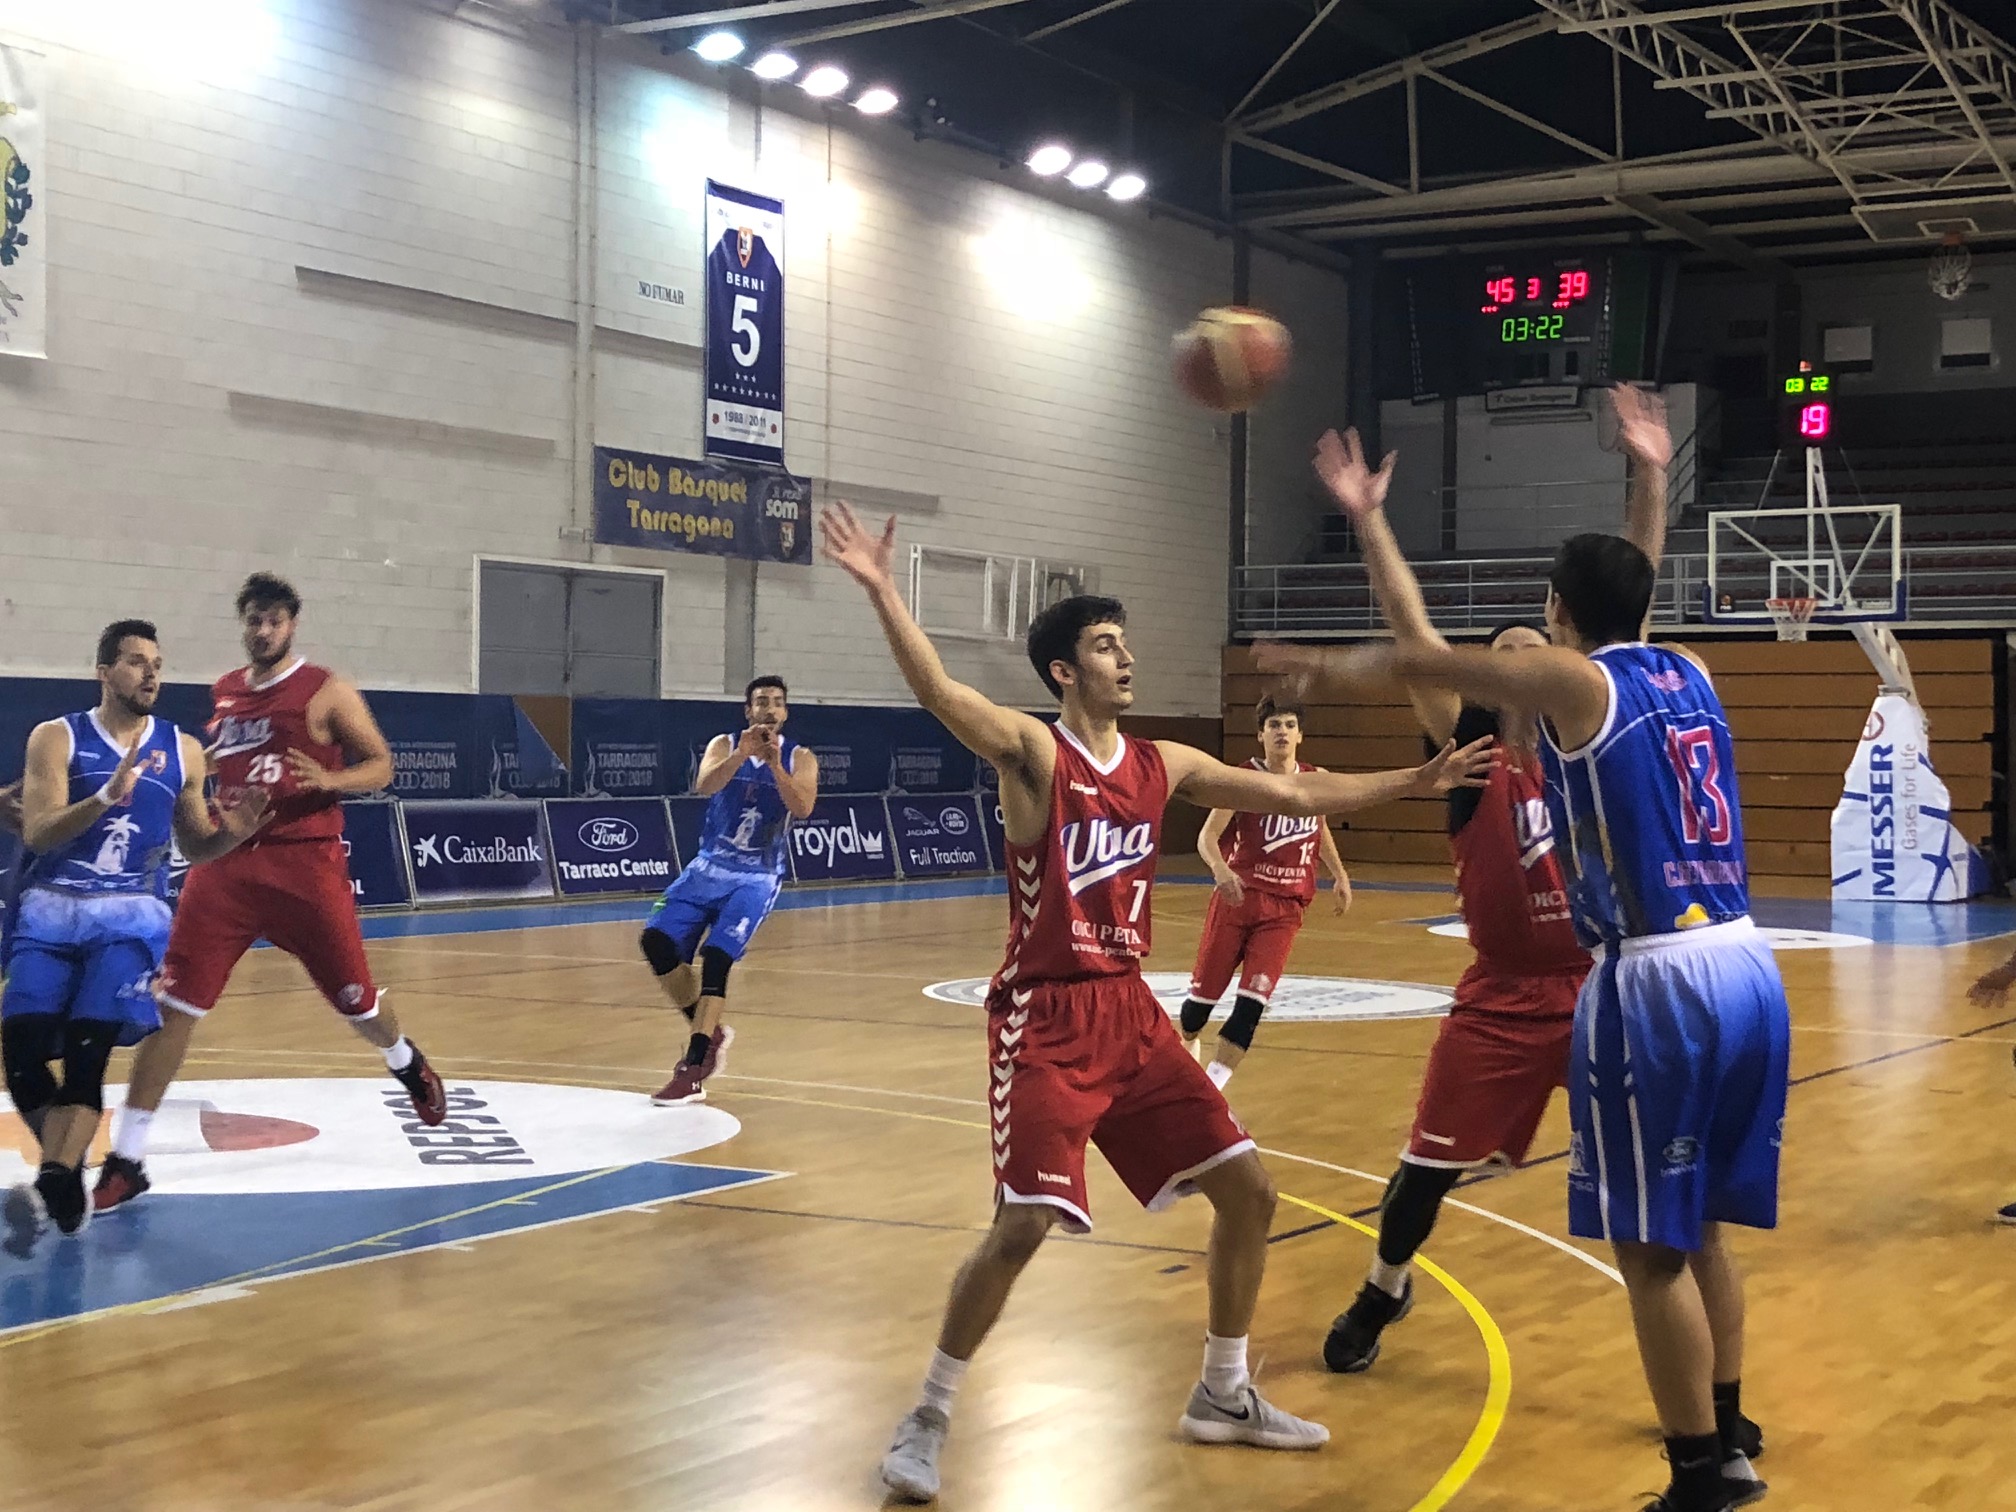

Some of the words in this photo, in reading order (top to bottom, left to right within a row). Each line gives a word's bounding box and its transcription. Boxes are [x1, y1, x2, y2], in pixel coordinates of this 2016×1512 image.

[639, 281, 651, 298] NO
[652, 282, 685, 305] FUMAR
[726, 271, 765, 292] BERNI
[1486, 277, 1516, 303] 45
[1526, 277, 1541, 299] 3
[1558, 271, 1588, 298] 39
[731, 293, 760, 367] 5
[1501, 314, 1564, 342] 03:22
[1785, 378, 1804, 393] 03
[1810, 376, 1829, 391] 22
[1801, 404, 1827, 435] 19
[608, 458, 660, 493] Club
[626, 499, 734, 543] Tarragona
[765, 499, 799, 520] som
[245, 753, 283, 784] 25
[392, 752, 457, 769] ARRAGONA
[599, 752, 658, 768] TARRAGONA
[1900, 743, 1917, 770] Life
[420, 772, 451, 789] 2018
[1664, 724, 1731, 846] 13
[1901, 777, 1916, 798] for
[905, 828, 940, 837] JAGUAR
[1869, 743, 1896, 897] MESSER
[1901, 803, 1918, 850] Gases
[591, 822, 628, 846] Ford
[793, 807, 862, 868] royal
[443, 834, 543, 864] CaixaBank
[909, 850, 931, 866] Full
[934, 846, 976, 865] Traction
[559, 861, 619, 879] Tarraco
[620, 858, 669, 877] Center
[1127, 879, 1148, 922] 7
